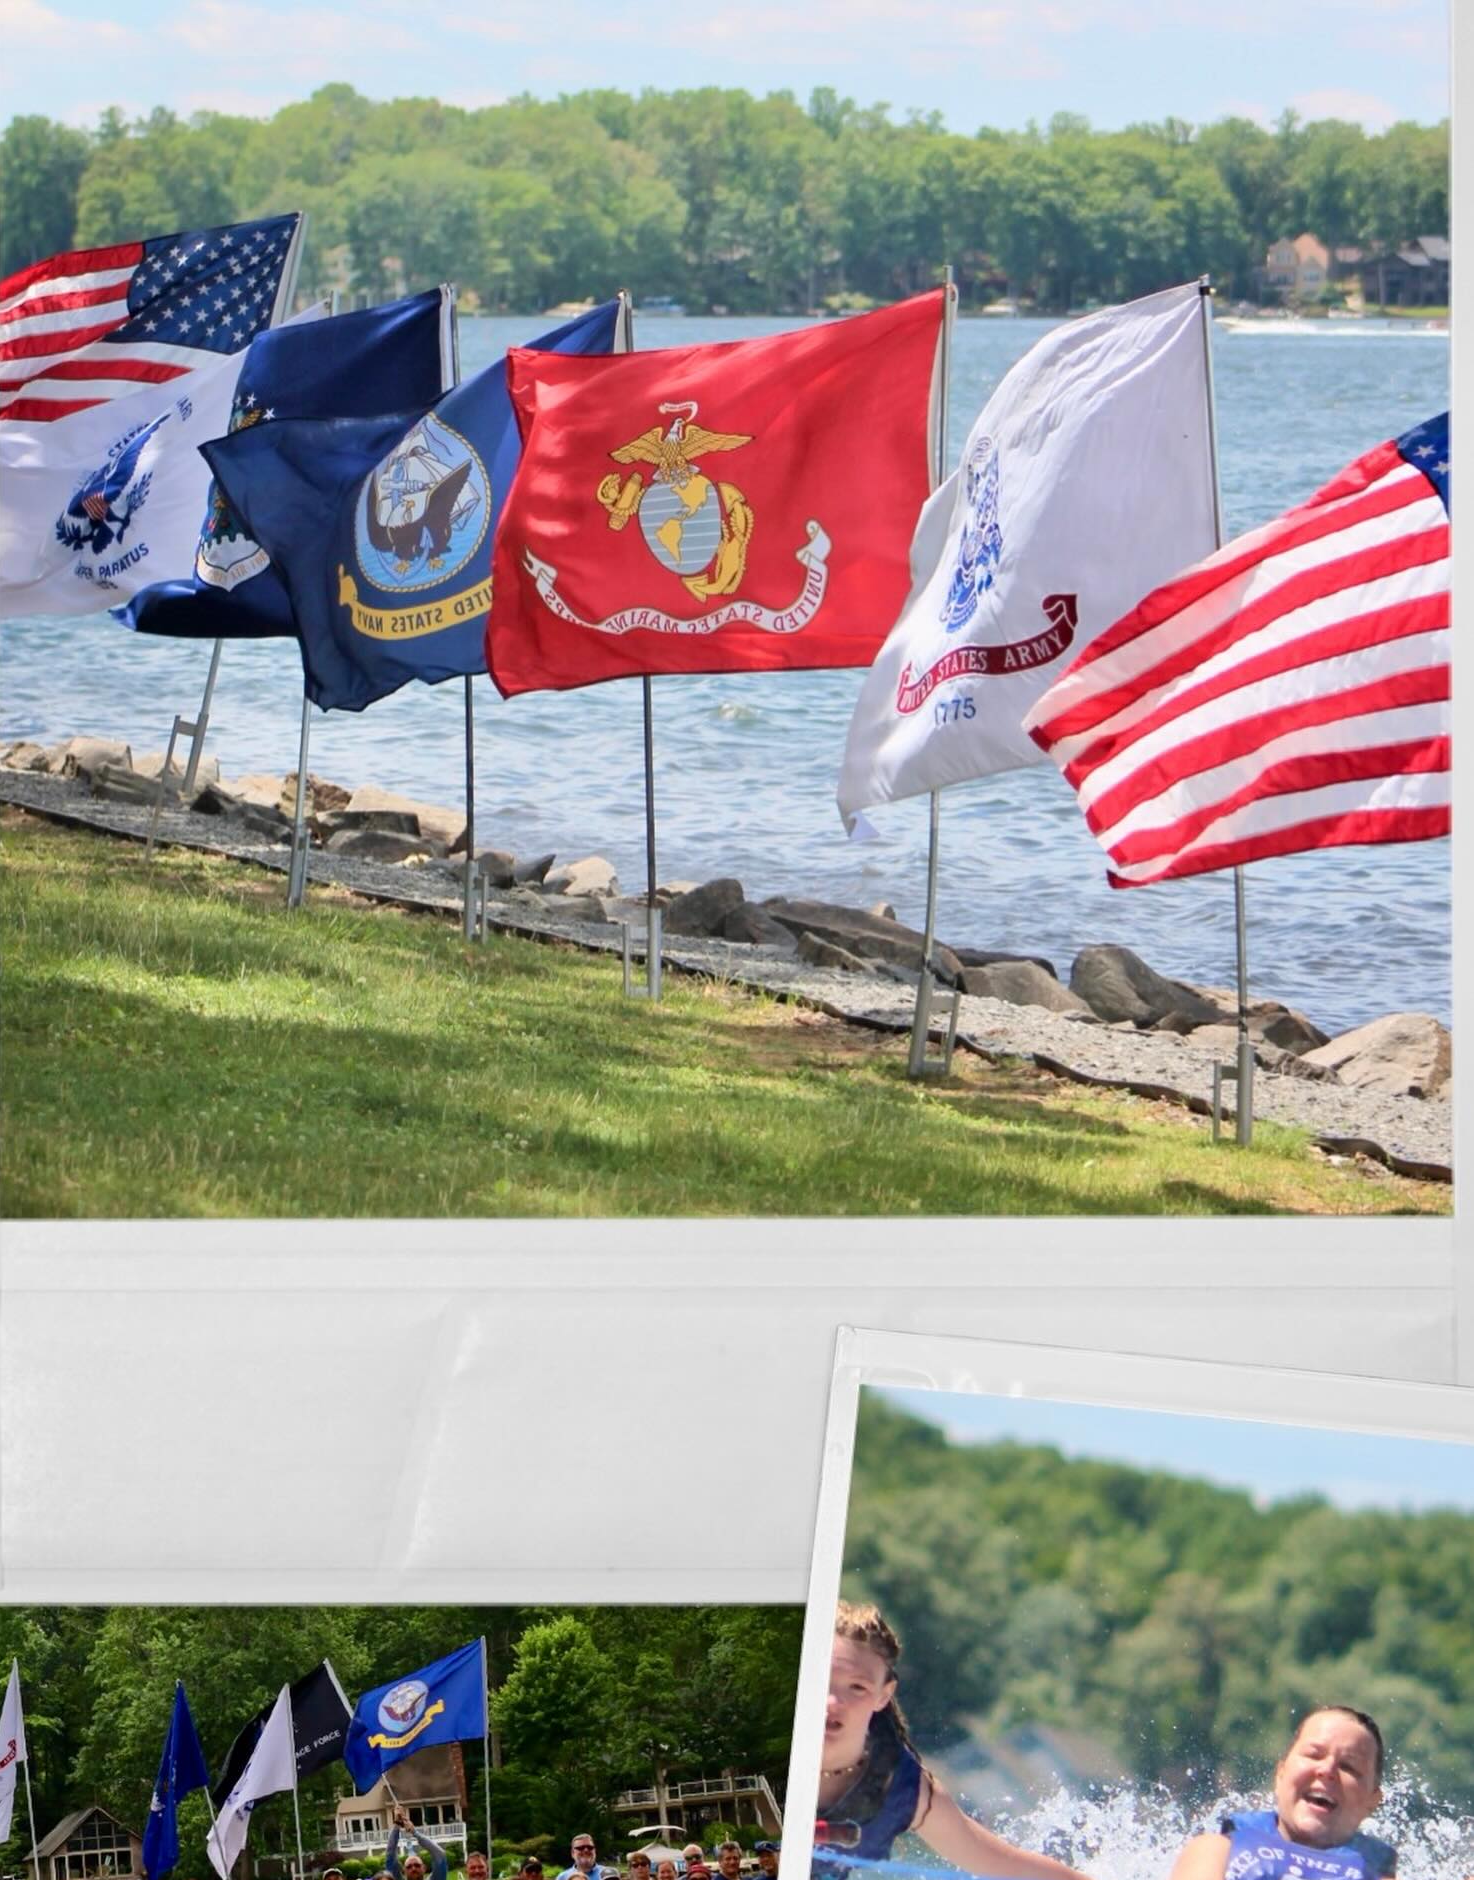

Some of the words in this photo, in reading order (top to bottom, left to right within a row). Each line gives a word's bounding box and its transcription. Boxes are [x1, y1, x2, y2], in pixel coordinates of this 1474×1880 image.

[98, 543, 149, 578] PARATUS
[937, 650, 990, 682] STATES
[1004, 631, 1067, 668] ARMY
[935, 697, 976, 724] 1775
[313, 1729, 342, 1748] FORCE
[1257, 1847, 1285, 1860] OF
[1290, 1852, 1341, 1874] THE
